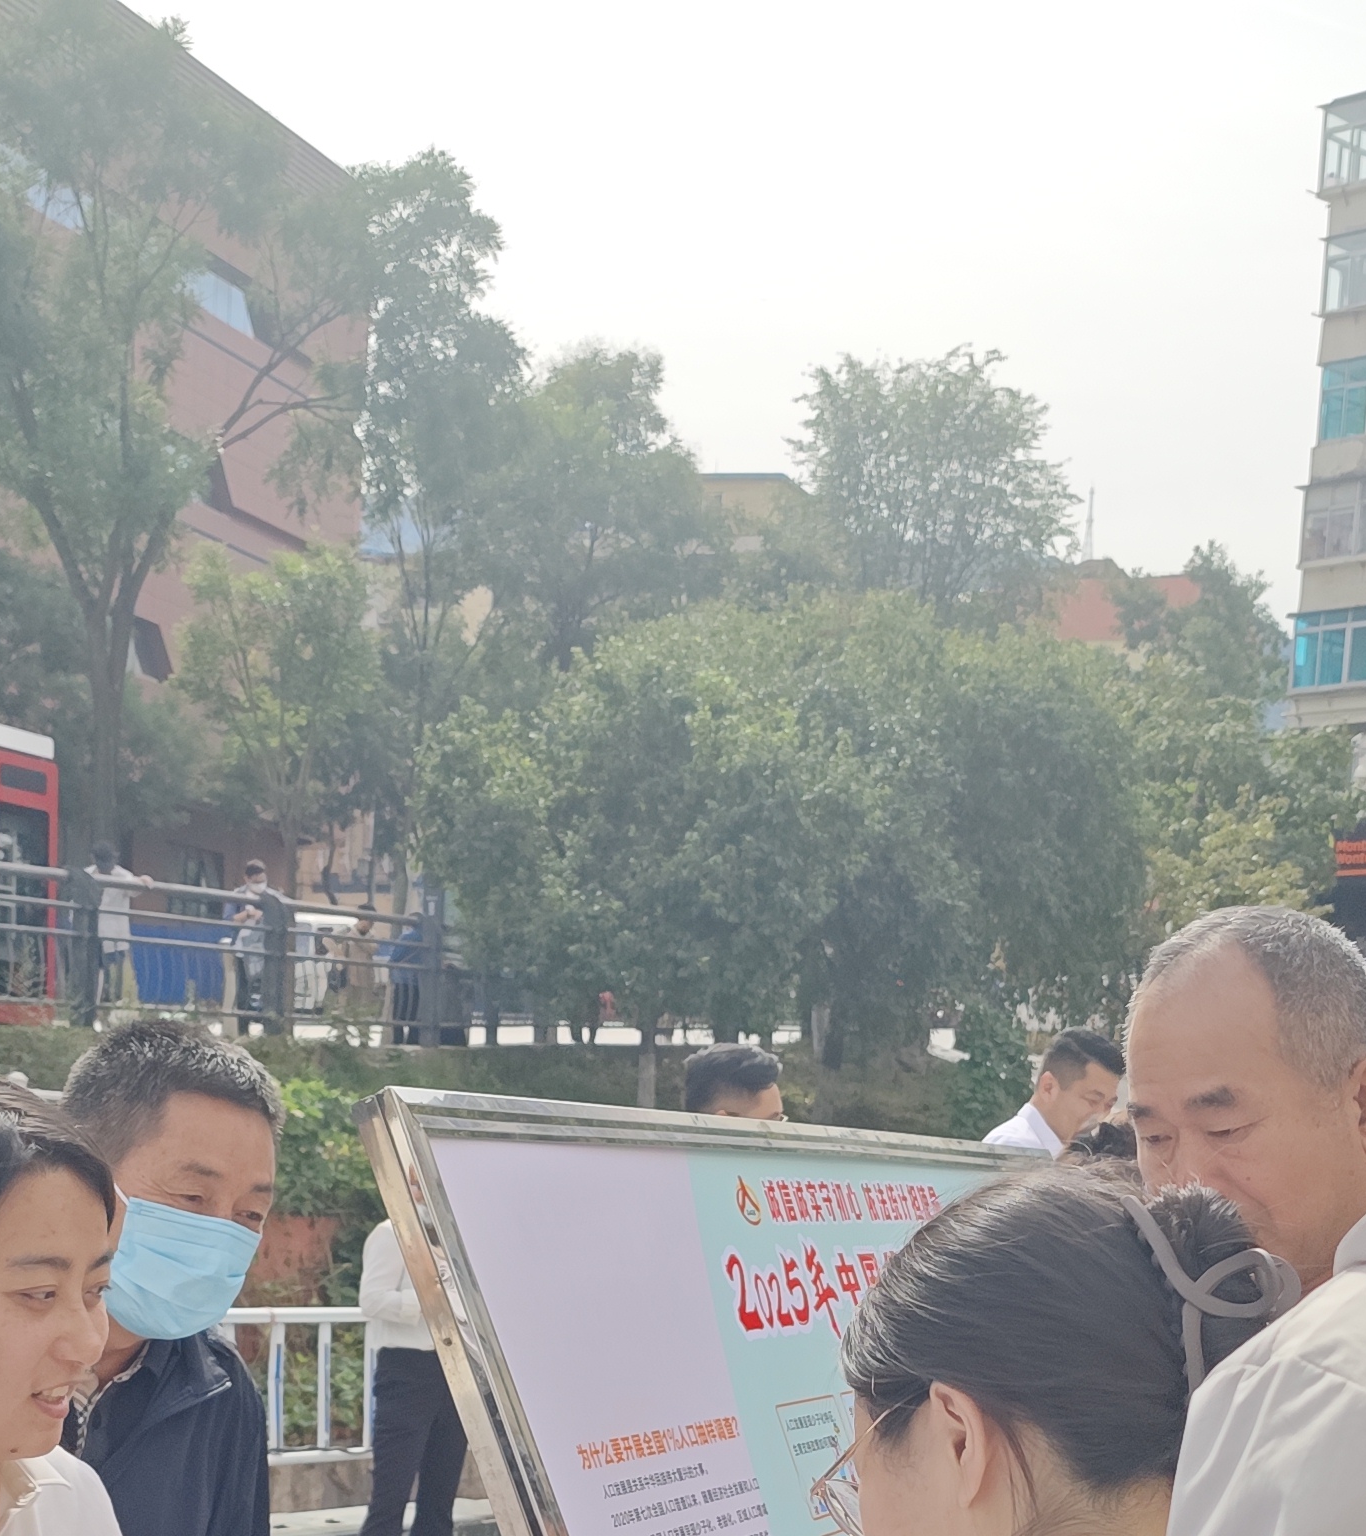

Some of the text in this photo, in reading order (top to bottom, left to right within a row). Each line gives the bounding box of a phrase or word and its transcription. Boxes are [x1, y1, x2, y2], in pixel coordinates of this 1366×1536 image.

[762, 1179, 863, 1222] 诚信诚实守初心
[726, 1243, 897, 1339] 2025年中国
